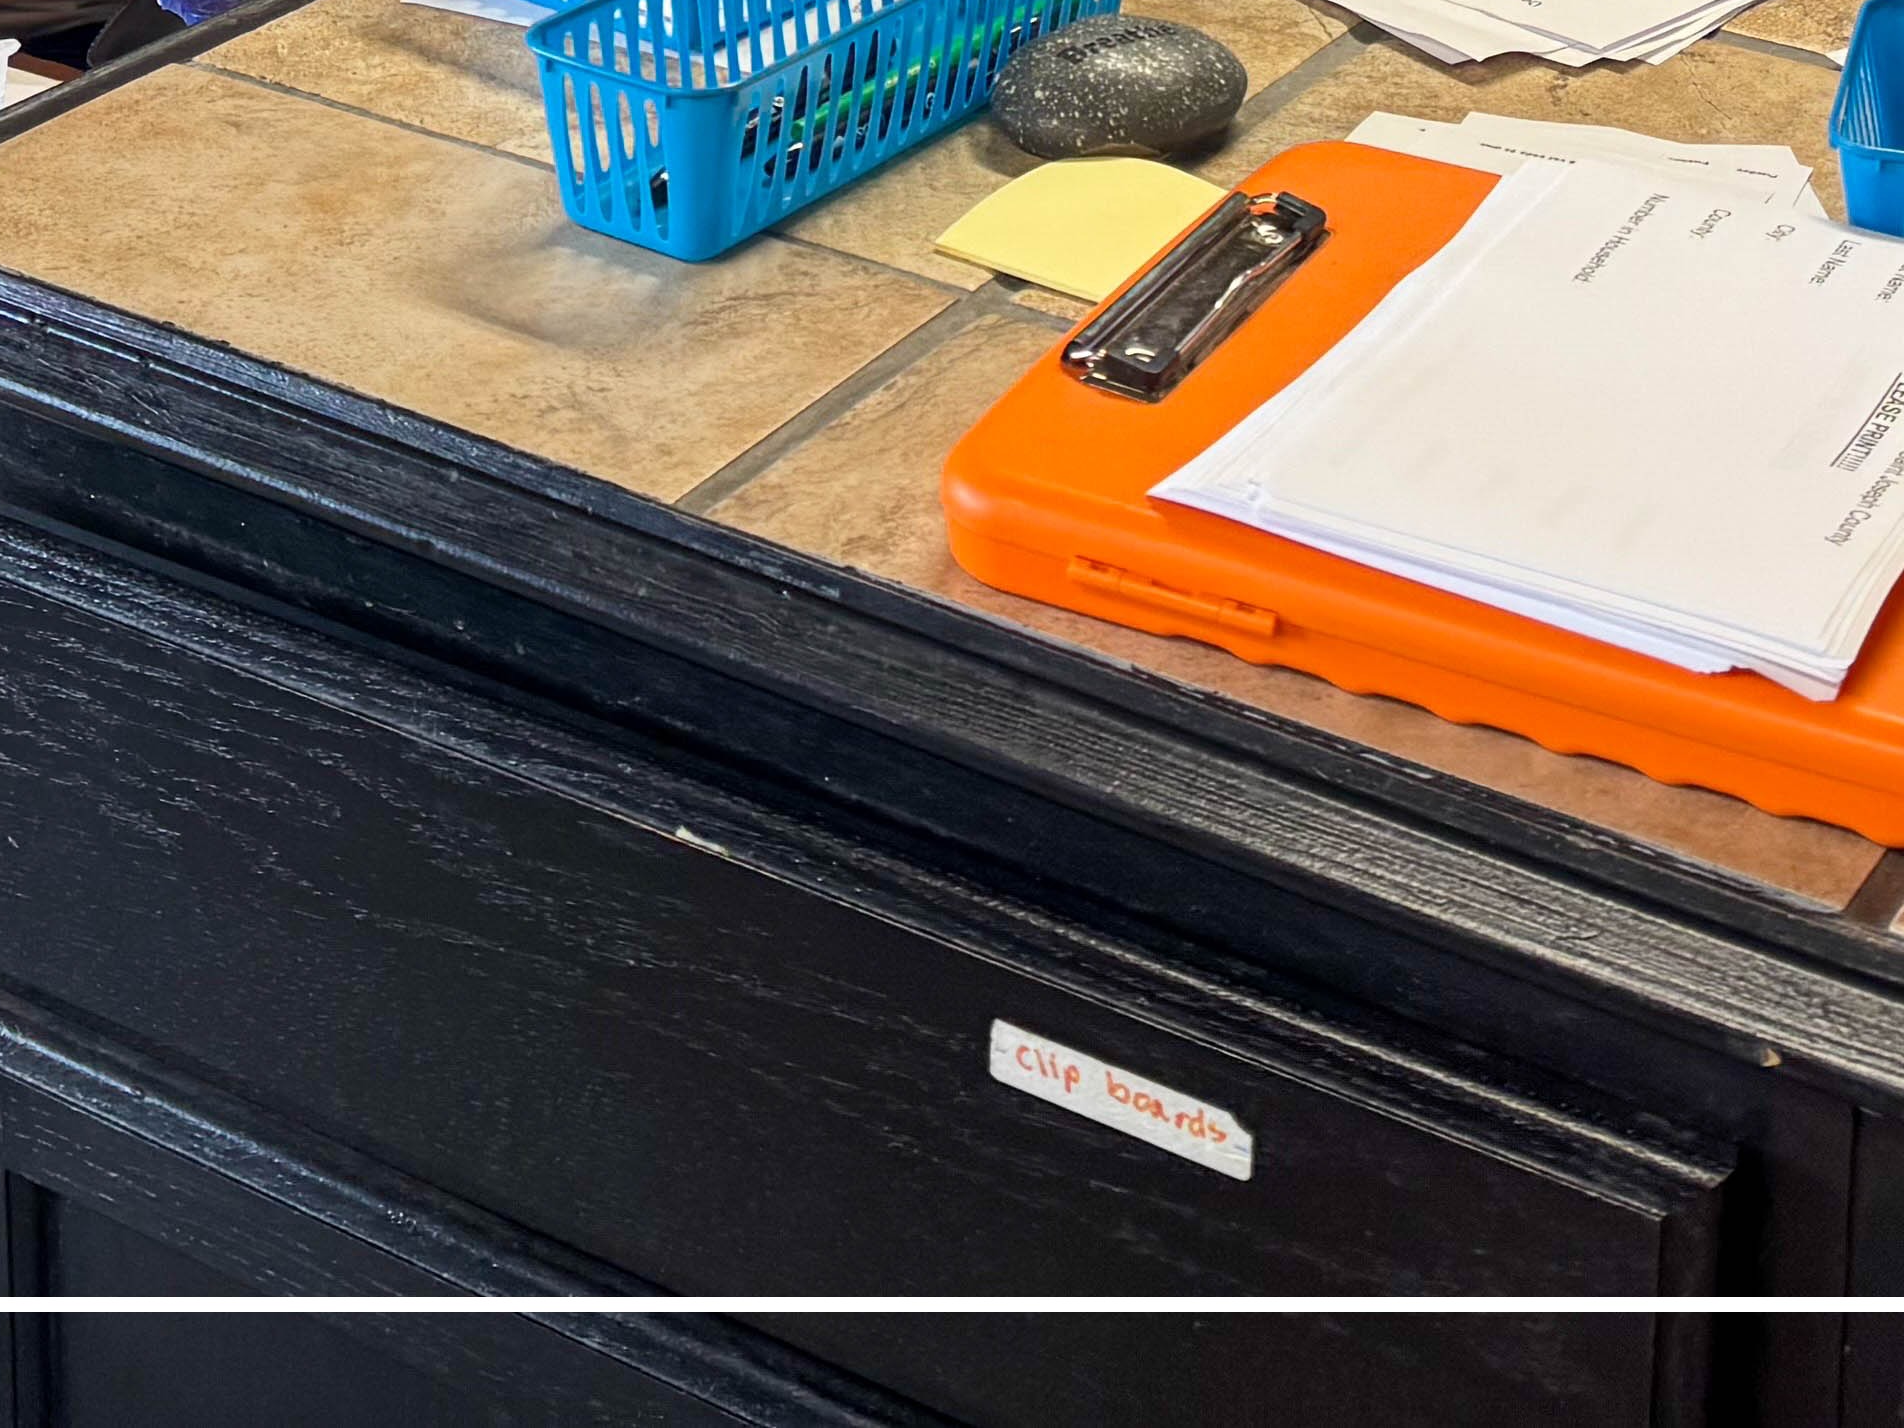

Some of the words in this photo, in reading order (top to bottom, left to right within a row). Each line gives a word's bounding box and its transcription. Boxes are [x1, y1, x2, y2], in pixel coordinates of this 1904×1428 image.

[1056, 22, 1178, 66] Breathe
[1859, 474, 1899, 515] Joseph
[1824, 510, 1873, 548] County
[1014, 1044, 1082, 1094] clip
[1105, 1070, 1229, 1144] boards
